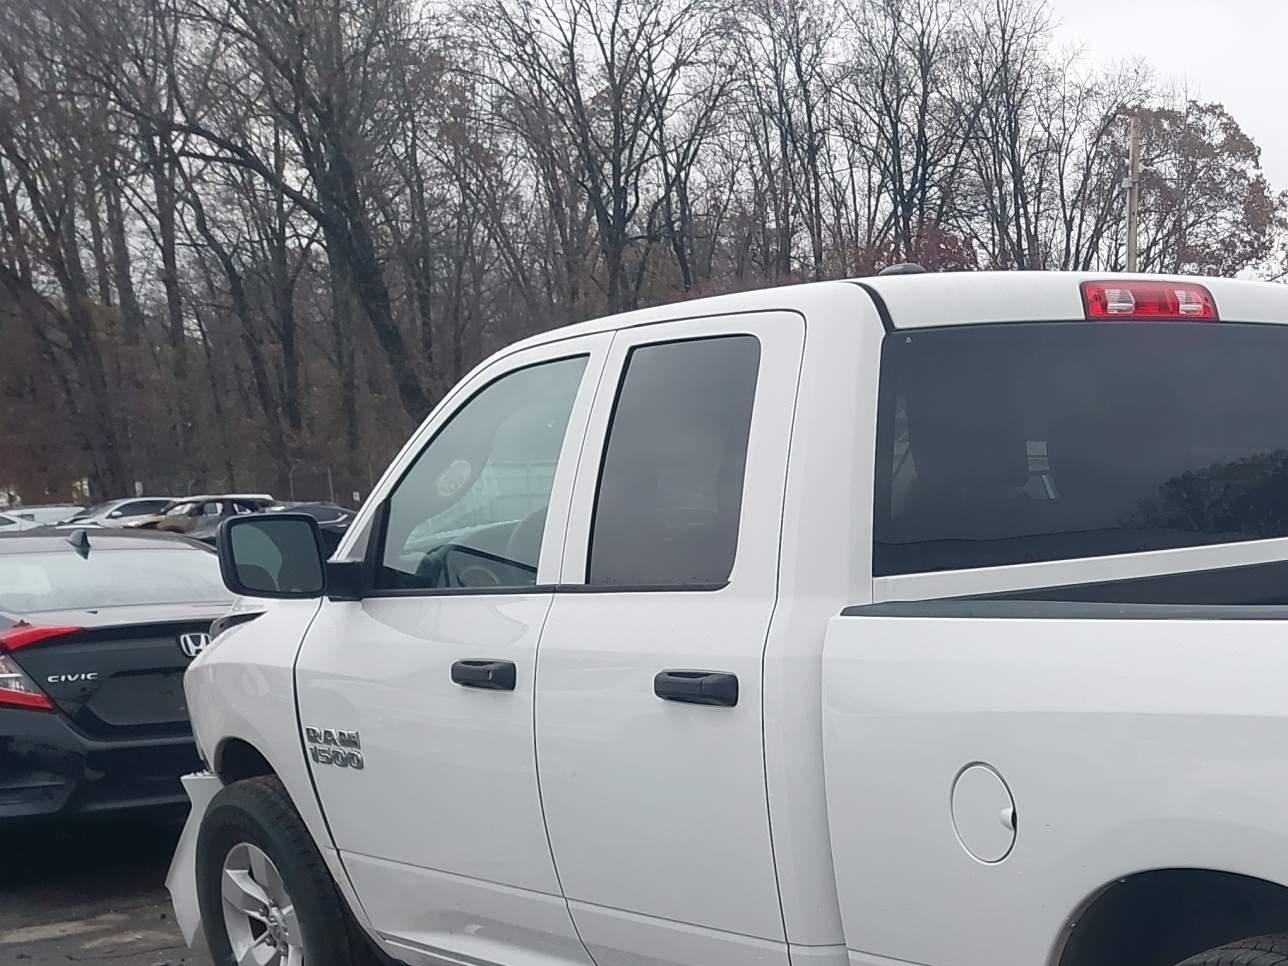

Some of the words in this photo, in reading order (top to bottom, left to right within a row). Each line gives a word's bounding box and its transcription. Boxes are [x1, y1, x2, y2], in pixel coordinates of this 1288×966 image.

[47, 672, 99, 683] CIVIC
[305, 727, 361, 749] RAM
[309, 746, 364, 770] 1500
